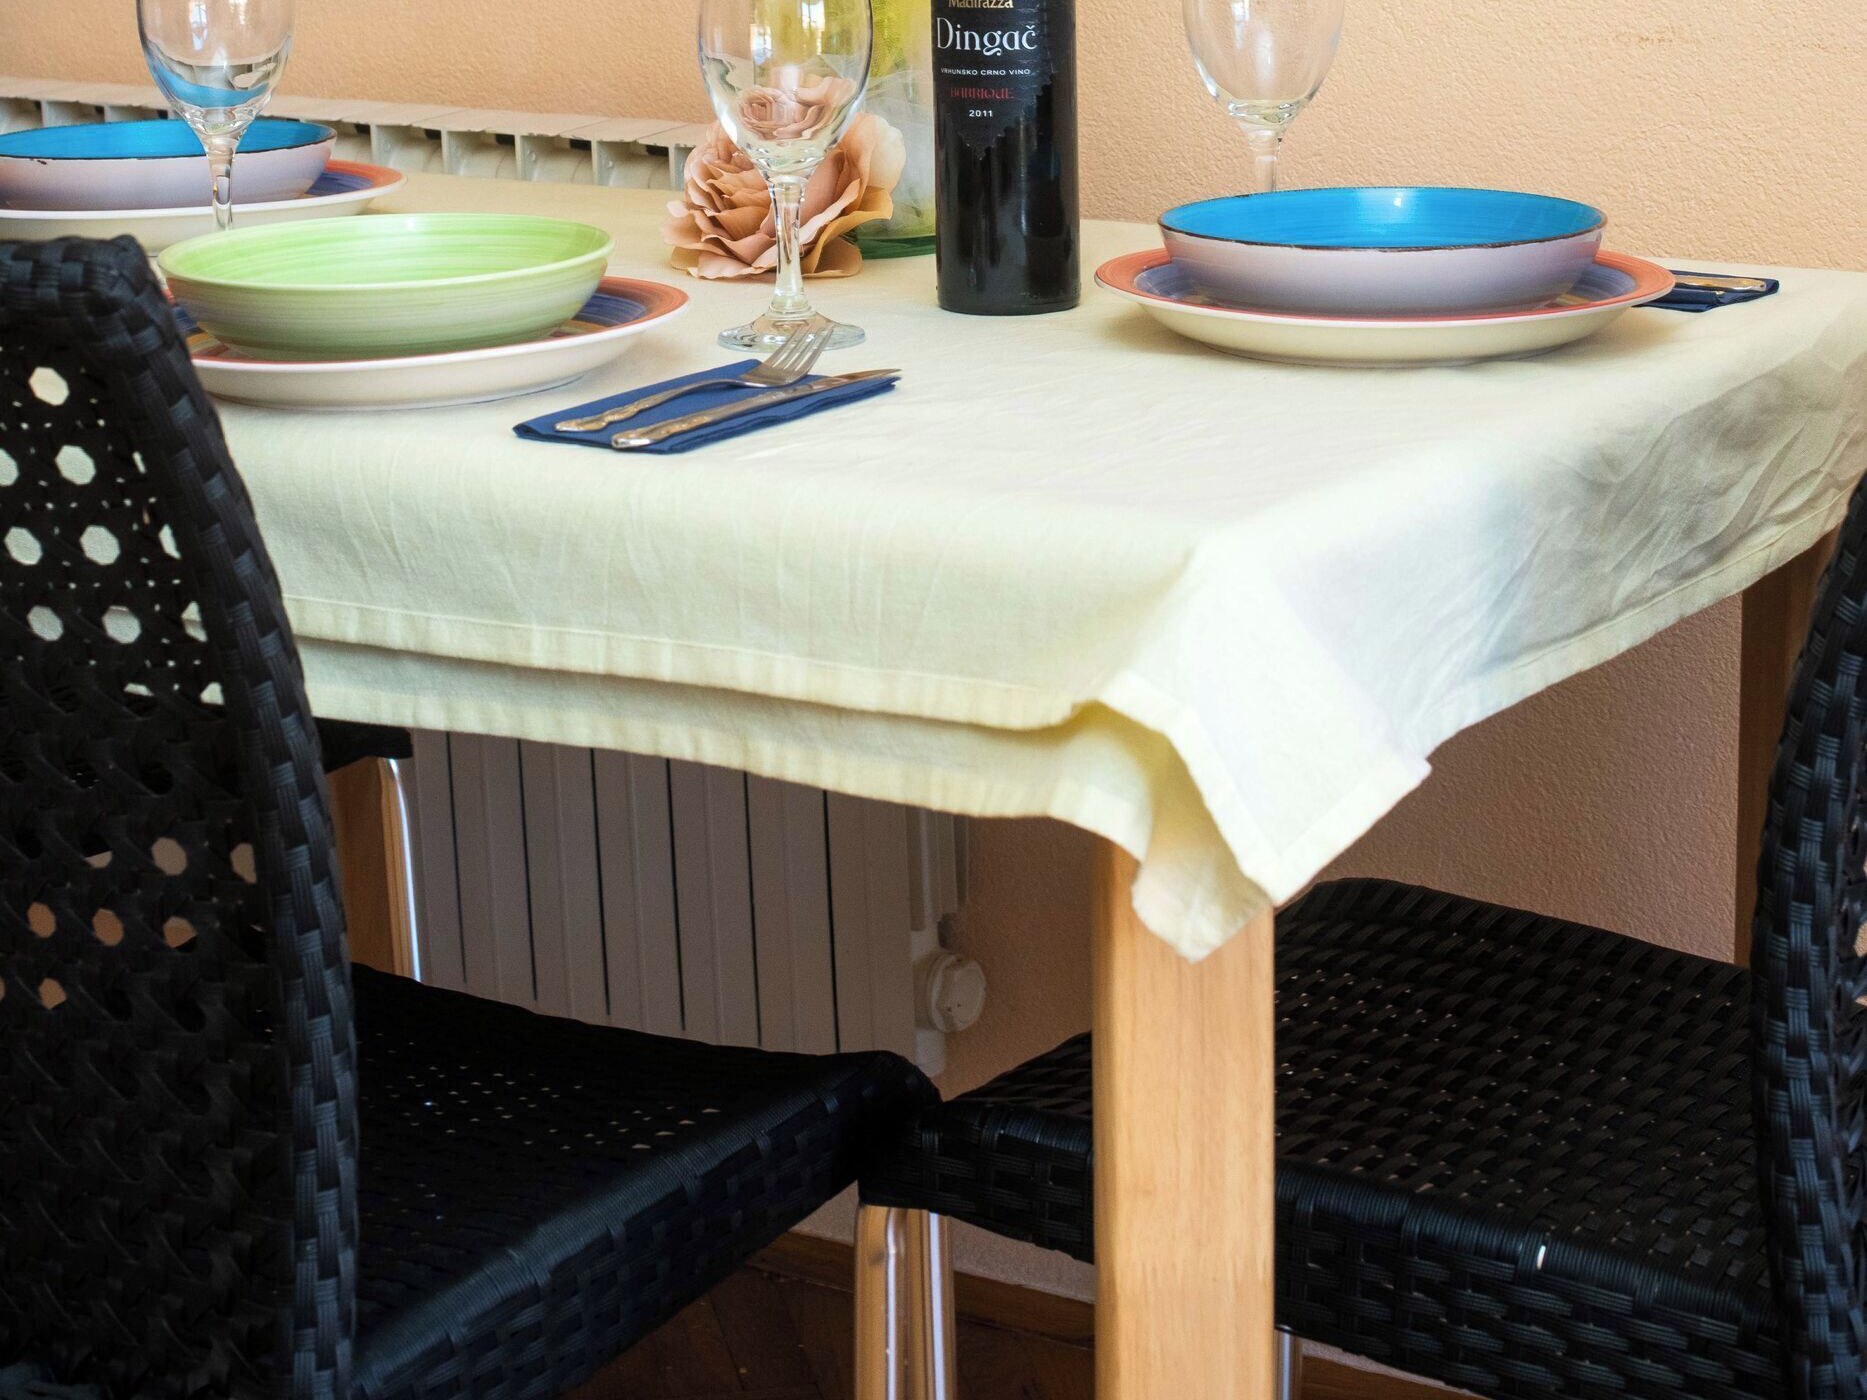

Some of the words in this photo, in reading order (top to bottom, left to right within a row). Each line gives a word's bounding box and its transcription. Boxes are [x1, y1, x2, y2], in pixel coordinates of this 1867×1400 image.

[936, 17, 1038, 56] Dingač
[941, 67, 978, 76] VRHUNSKO
[968, 109, 993, 118] 2011
